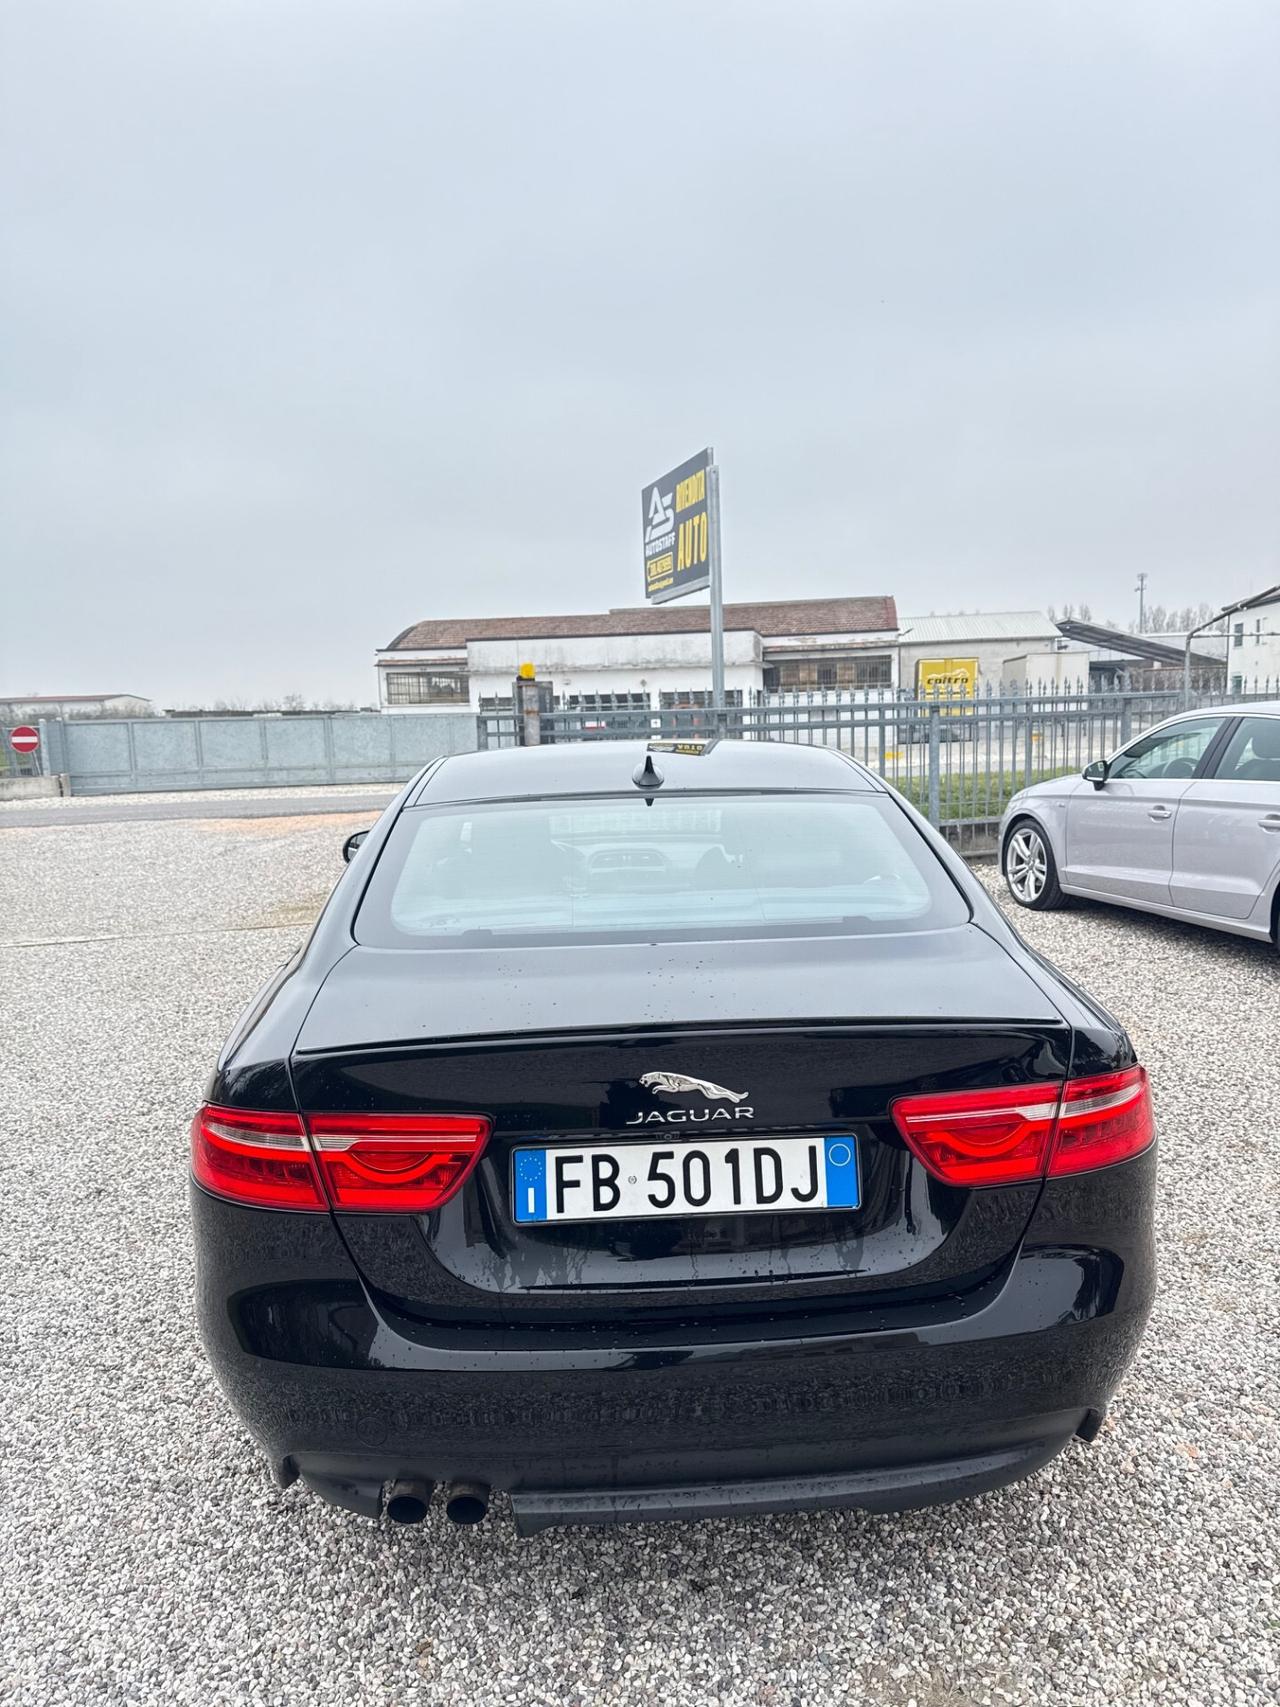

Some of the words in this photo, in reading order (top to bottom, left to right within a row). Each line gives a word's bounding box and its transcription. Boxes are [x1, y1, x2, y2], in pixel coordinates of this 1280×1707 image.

[645, 531, 676, 557] AUTOSTAFF
[677, 511, 707, 572] AUTO
[626, 1106, 755, 1125] JAGUAR
[555, 1153, 621, 1213] FB
[647, 1145, 819, 1209] 501DJ
